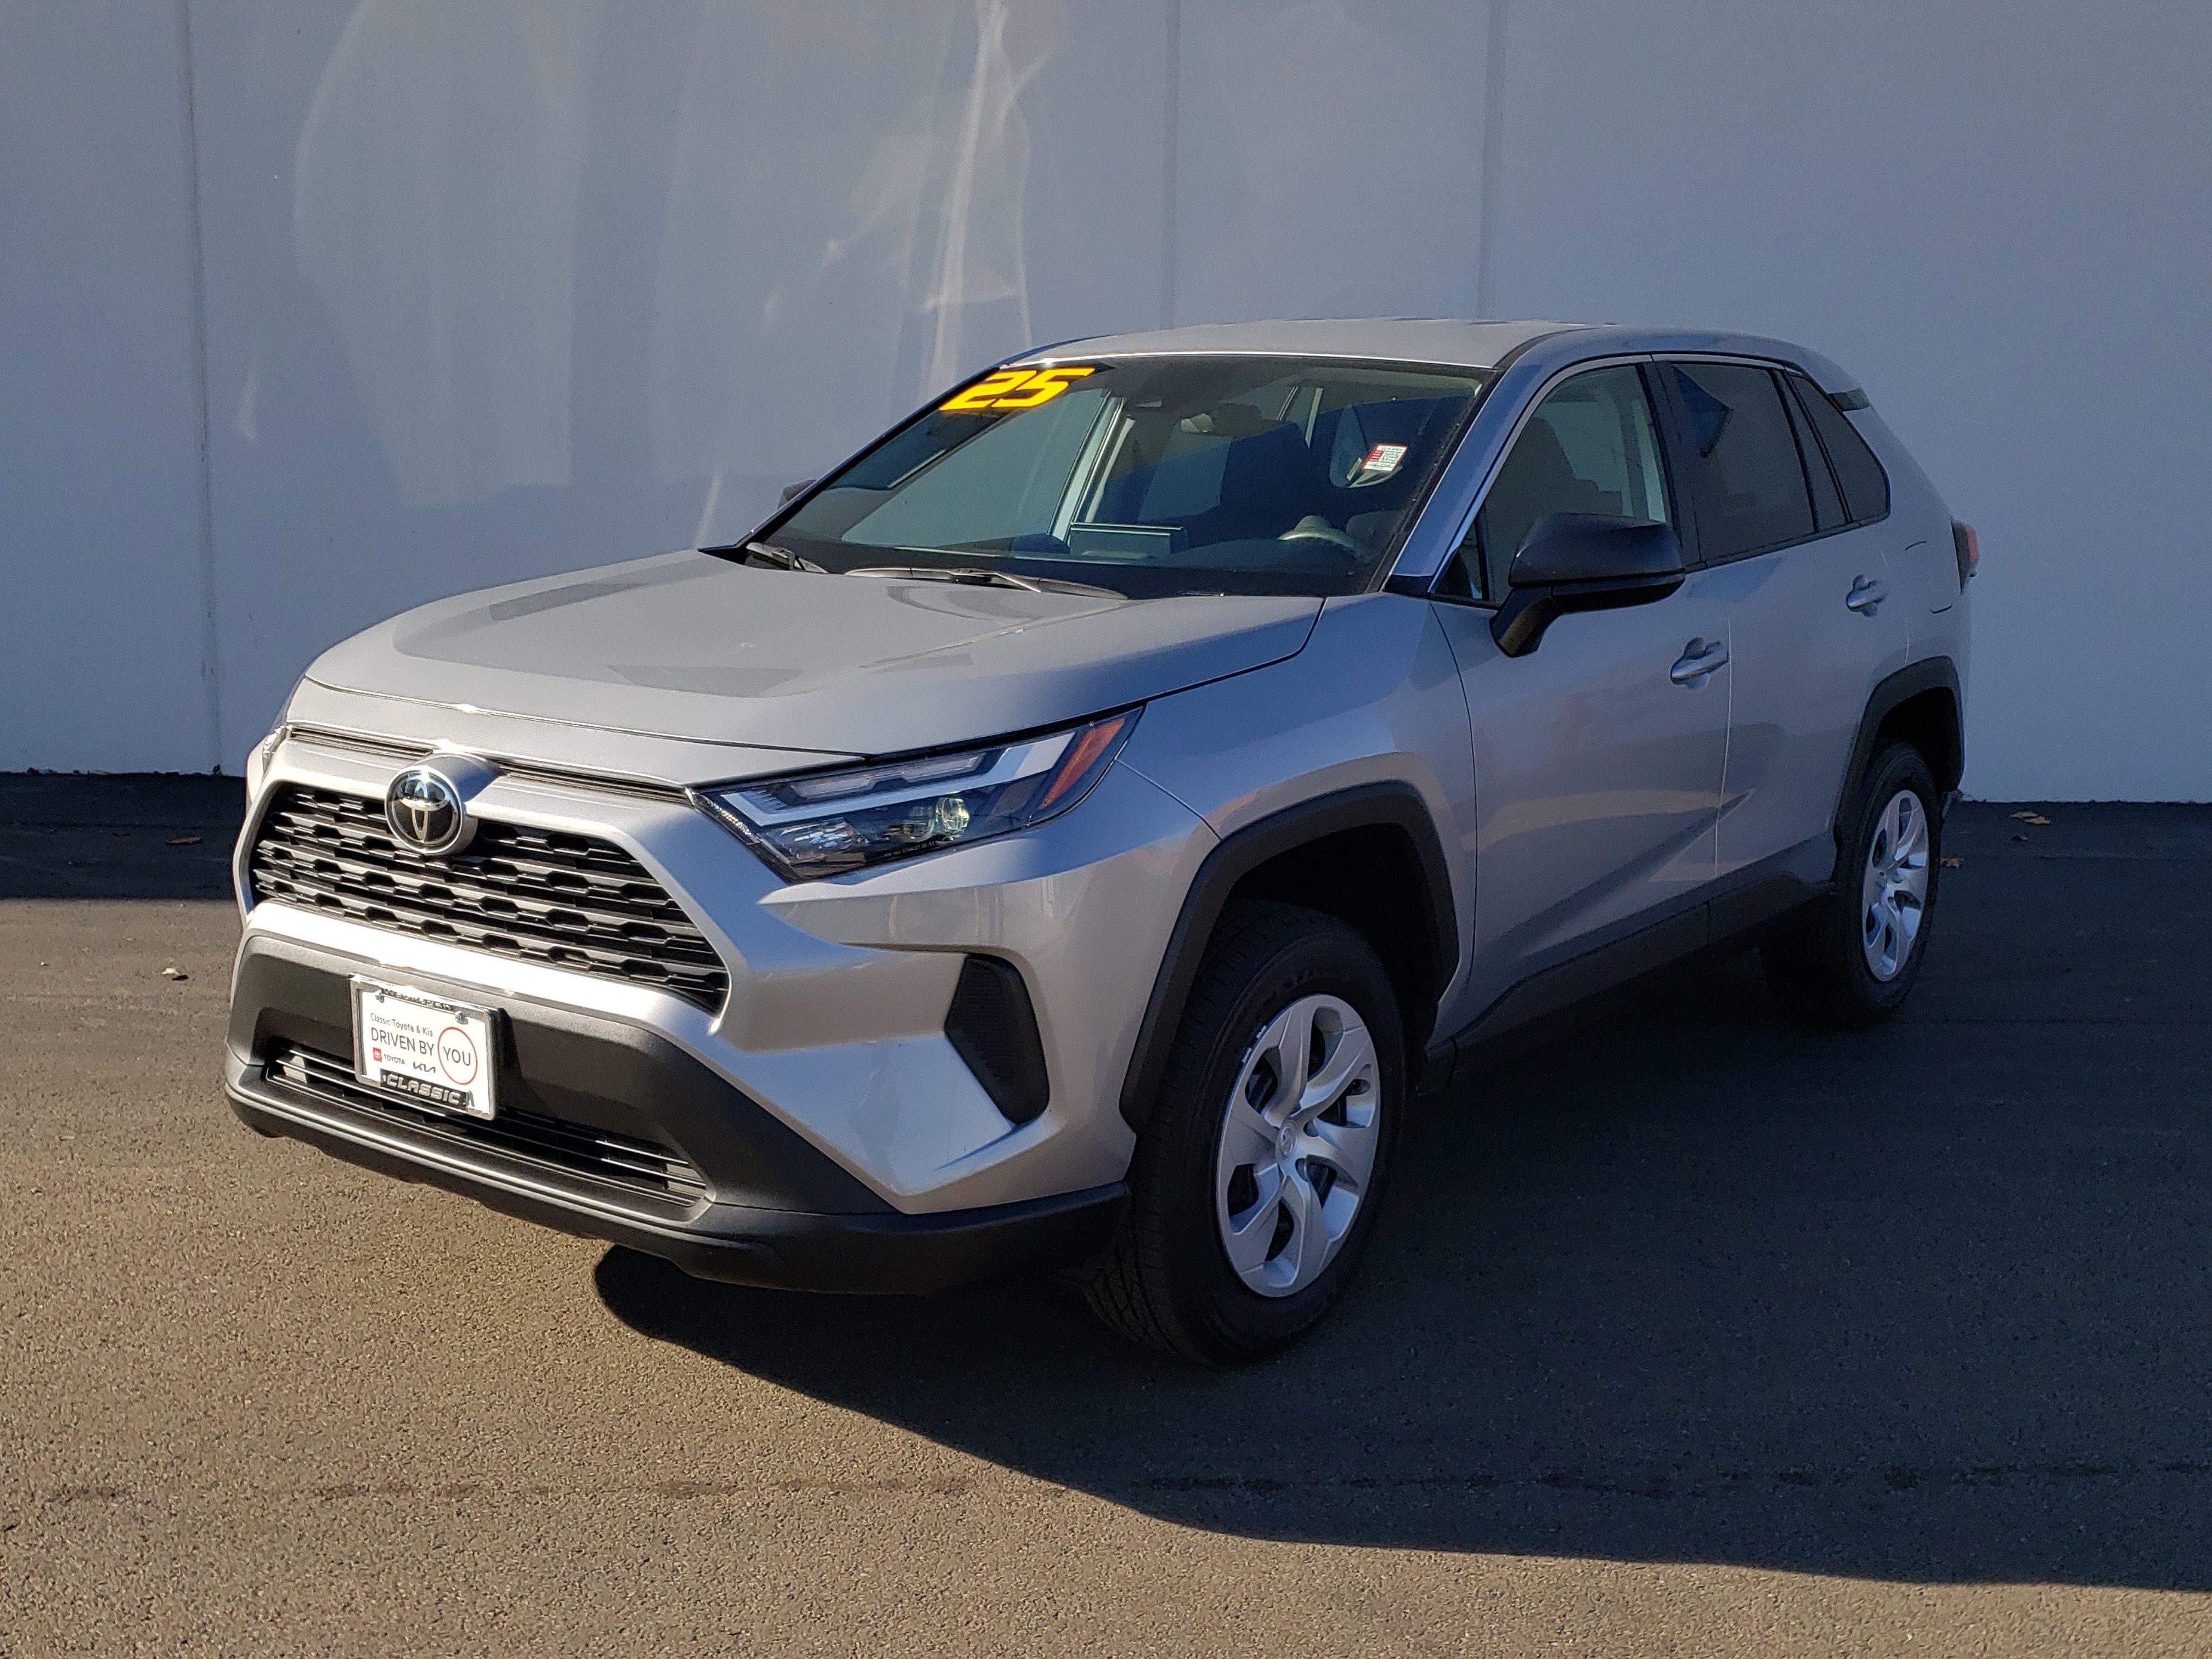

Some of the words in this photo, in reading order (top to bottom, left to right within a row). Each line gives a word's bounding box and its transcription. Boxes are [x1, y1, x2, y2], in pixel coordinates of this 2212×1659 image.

[939, 366, 1095, 411] 25
[370, 1013, 390, 1026] Classic
[392, 1019, 414, 1032] Toyota
[416, 1025, 421, 1034] &
[422, 1026, 433, 1037] Kia
[371, 1026, 416, 1052] DRIVEN
[419, 1040, 435, 1057] BY
[442, 1046, 471, 1066] YOU
[383, 1053, 405, 1065] TOYOTA
[386, 1073, 461, 1105] CLASSIC
